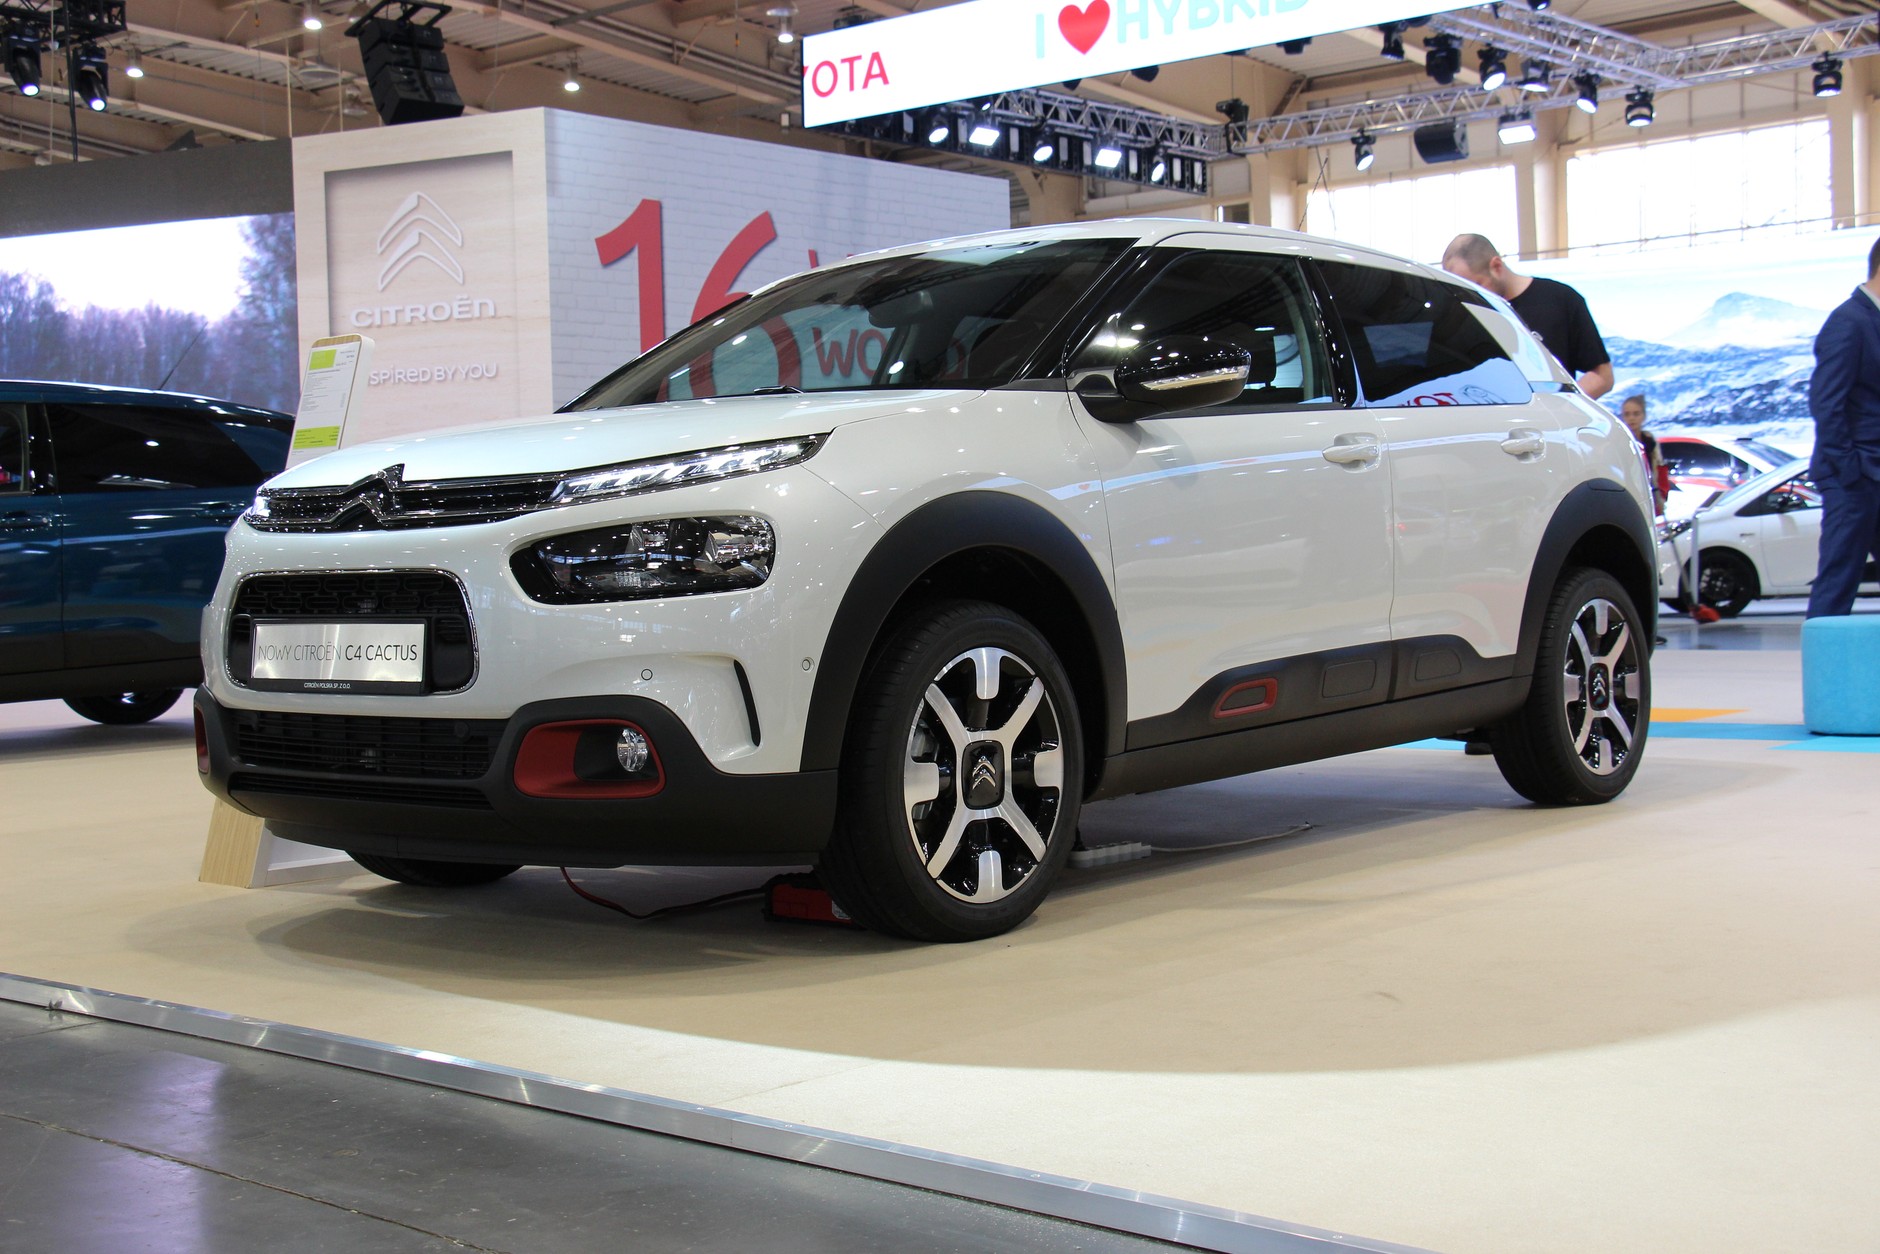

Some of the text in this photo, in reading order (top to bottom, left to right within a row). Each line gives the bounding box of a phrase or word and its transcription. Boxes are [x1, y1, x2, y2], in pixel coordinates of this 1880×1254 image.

[1035, 0, 1306, 59] I HYBR
[803, 51, 890, 98] OTA
[594, 198, 801, 400] 16
[434, 365, 457, 381] BY
[458, 360, 498, 380] YOU
[258, 641, 418, 661] NOWY CITROËN C4 CACTUS
